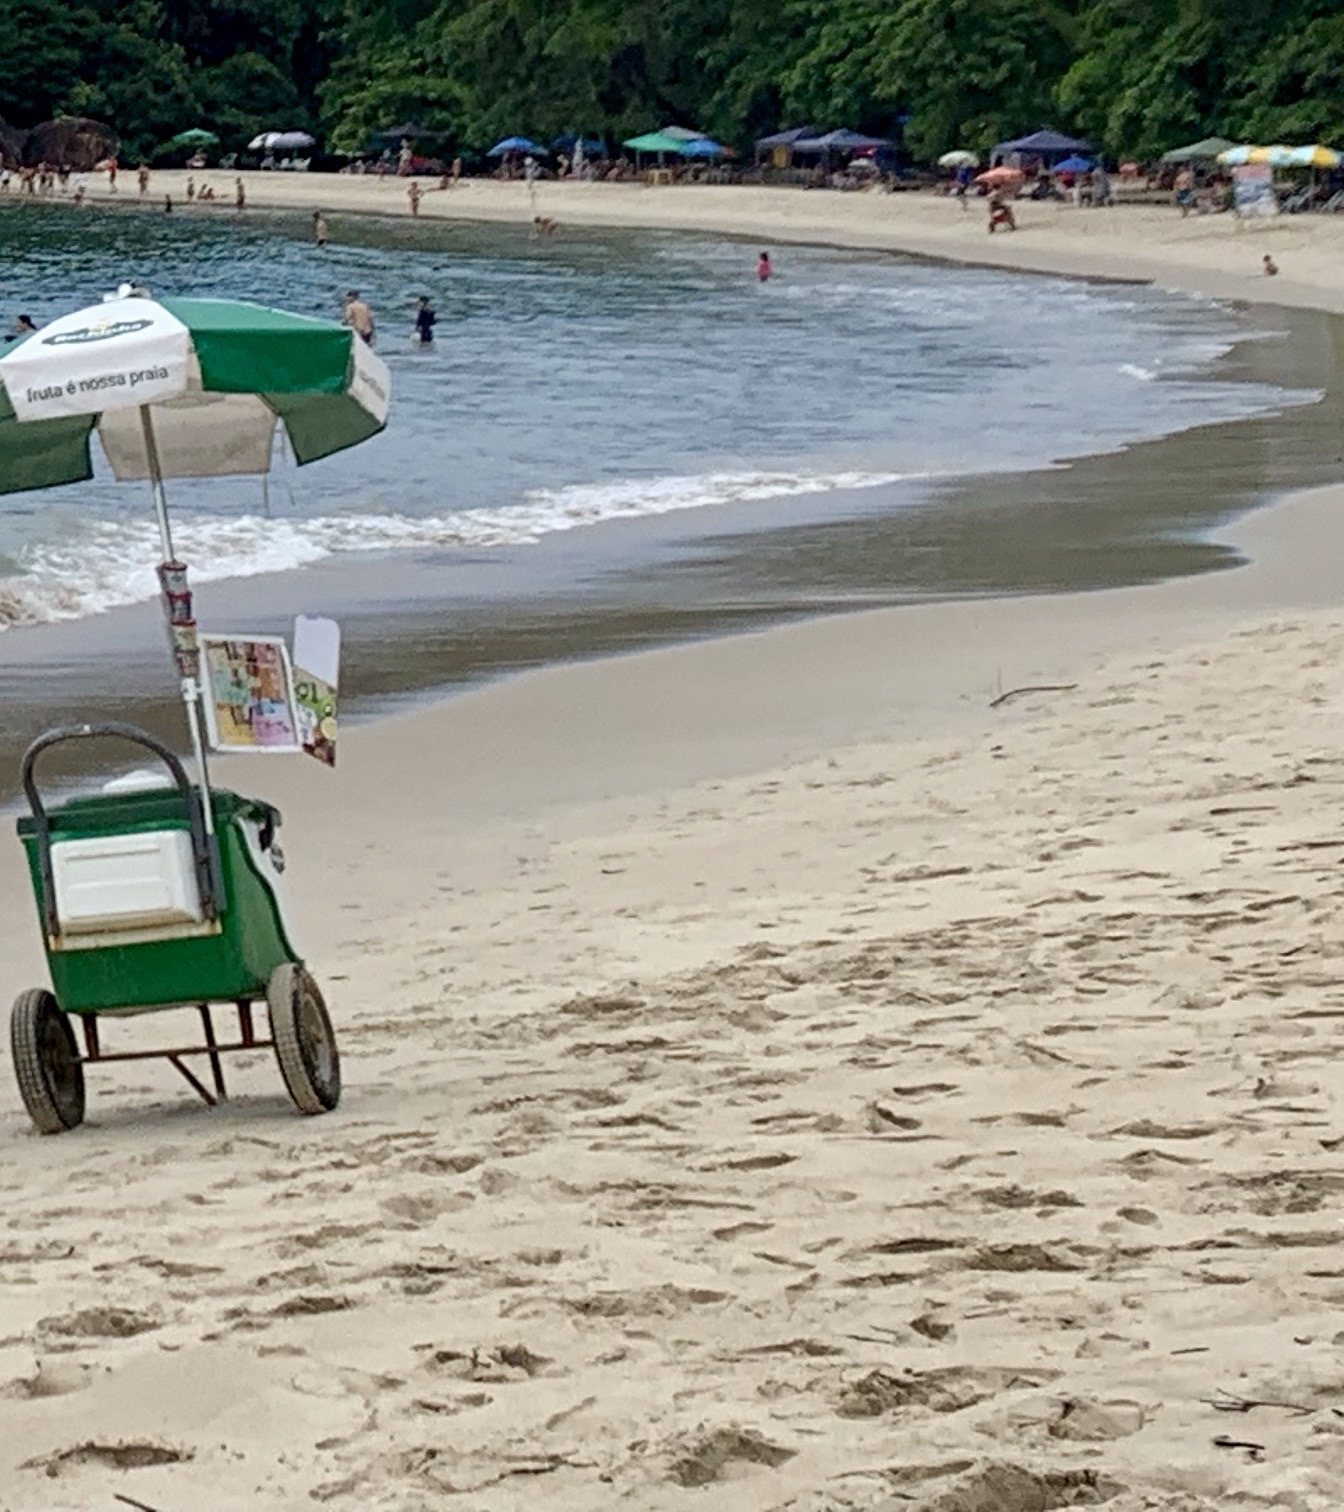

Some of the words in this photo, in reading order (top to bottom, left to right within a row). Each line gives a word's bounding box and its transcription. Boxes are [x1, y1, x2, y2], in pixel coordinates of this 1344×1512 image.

[27, 387, 63, 403] fruta
[66, 380, 77, 396] é
[79, 374, 127, 392] nossa
[129, 365, 169, 387] praia
